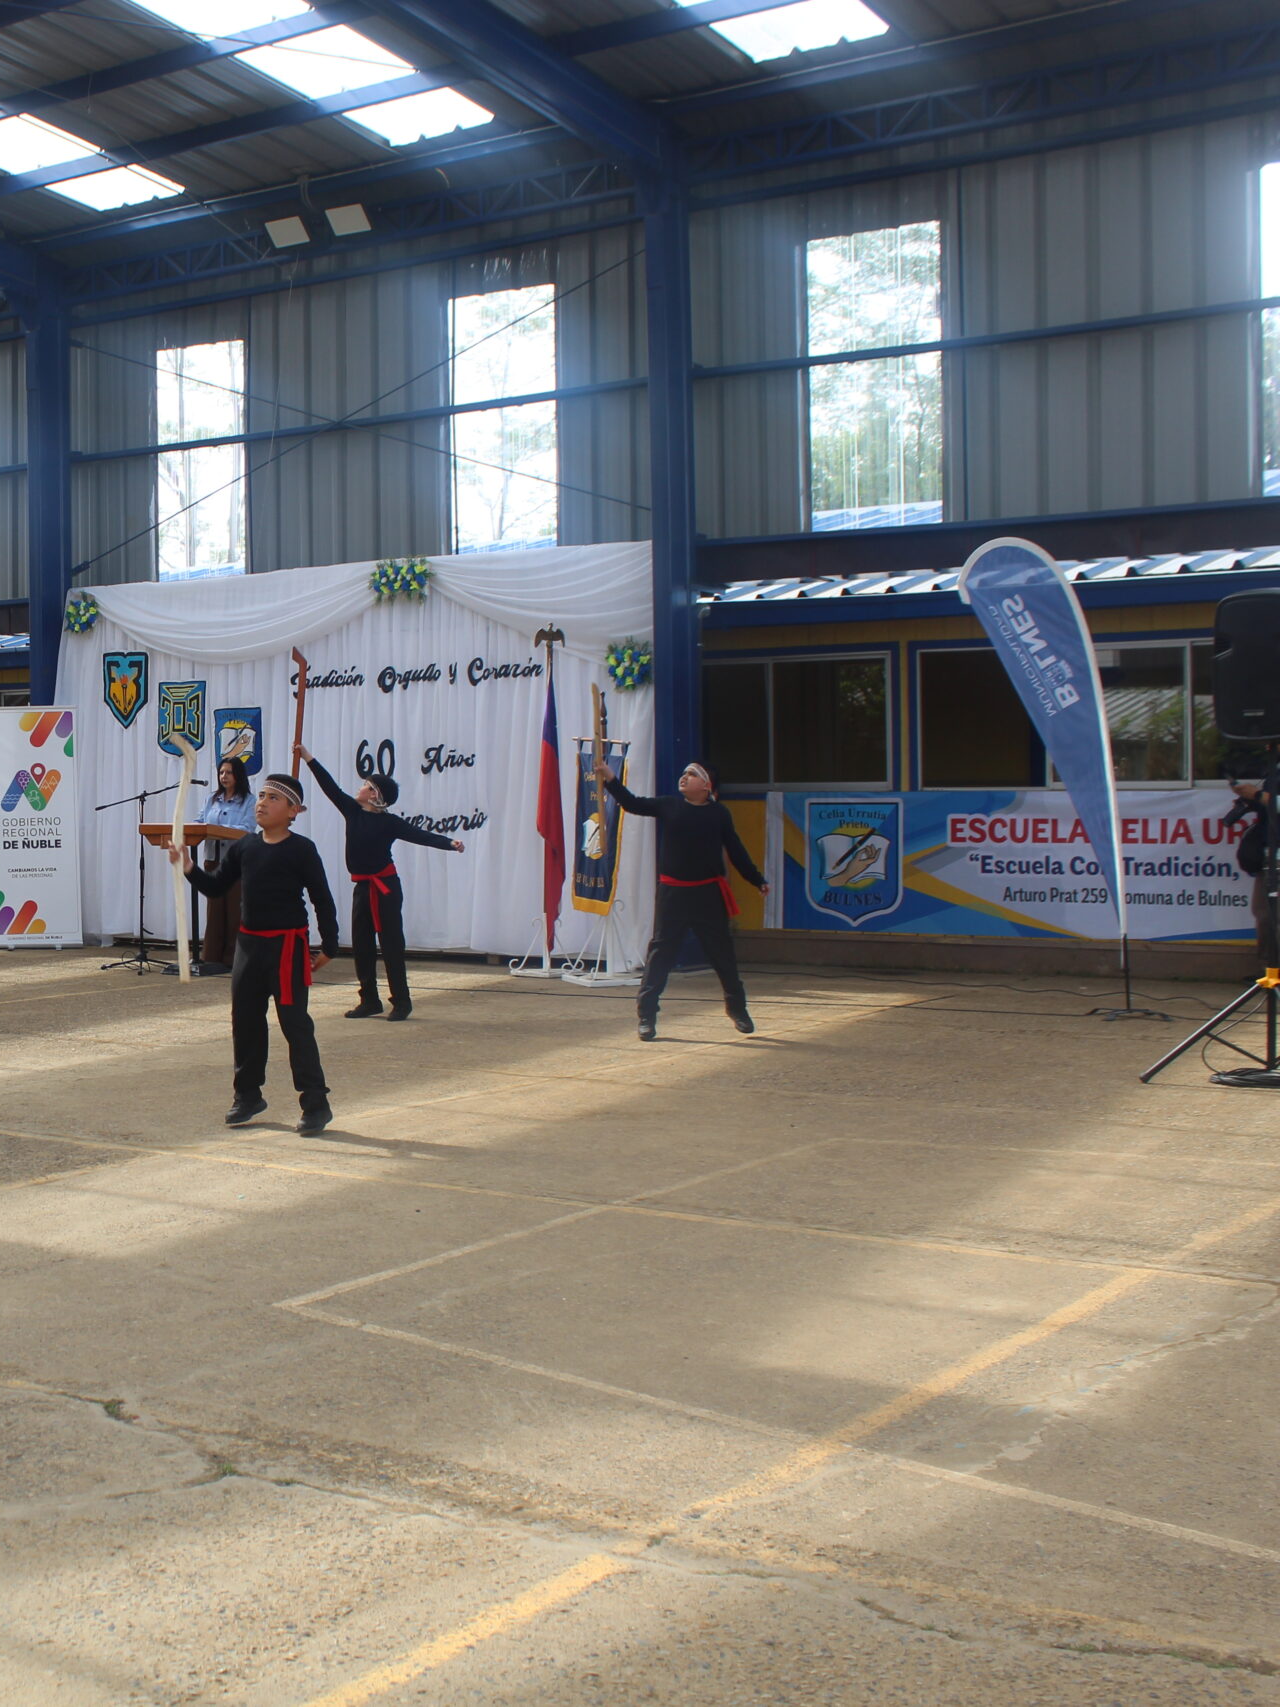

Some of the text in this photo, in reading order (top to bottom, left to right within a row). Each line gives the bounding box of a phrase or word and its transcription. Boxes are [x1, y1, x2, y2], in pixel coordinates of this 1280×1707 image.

[377, 663, 441, 693] Orgullo
[449, 662, 458, 685] y
[467, 657, 543, 686] Corazón
[356, 738, 475, 779] 60 Años
[2, 816, 61, 828] GOBIERNO
[400, 808, 487, 833] versario
[818, 808, 888, 820] Celia Urrutia
[2, 827, 62, 838] REGIONAL
[839, 820, 870, 829] Prieto
[950, 817, 1260, 845] ESCUELA ELIA UR
[3, 838, 62, 850] DE ÑUBLE
[969, 853, 1240, 880] “Escuela Co Tradición,
[823, 890, 882, 906] BULNES
[1003, 886, 1248, 907] Arturo Prat 259 omuna de Bulnes
